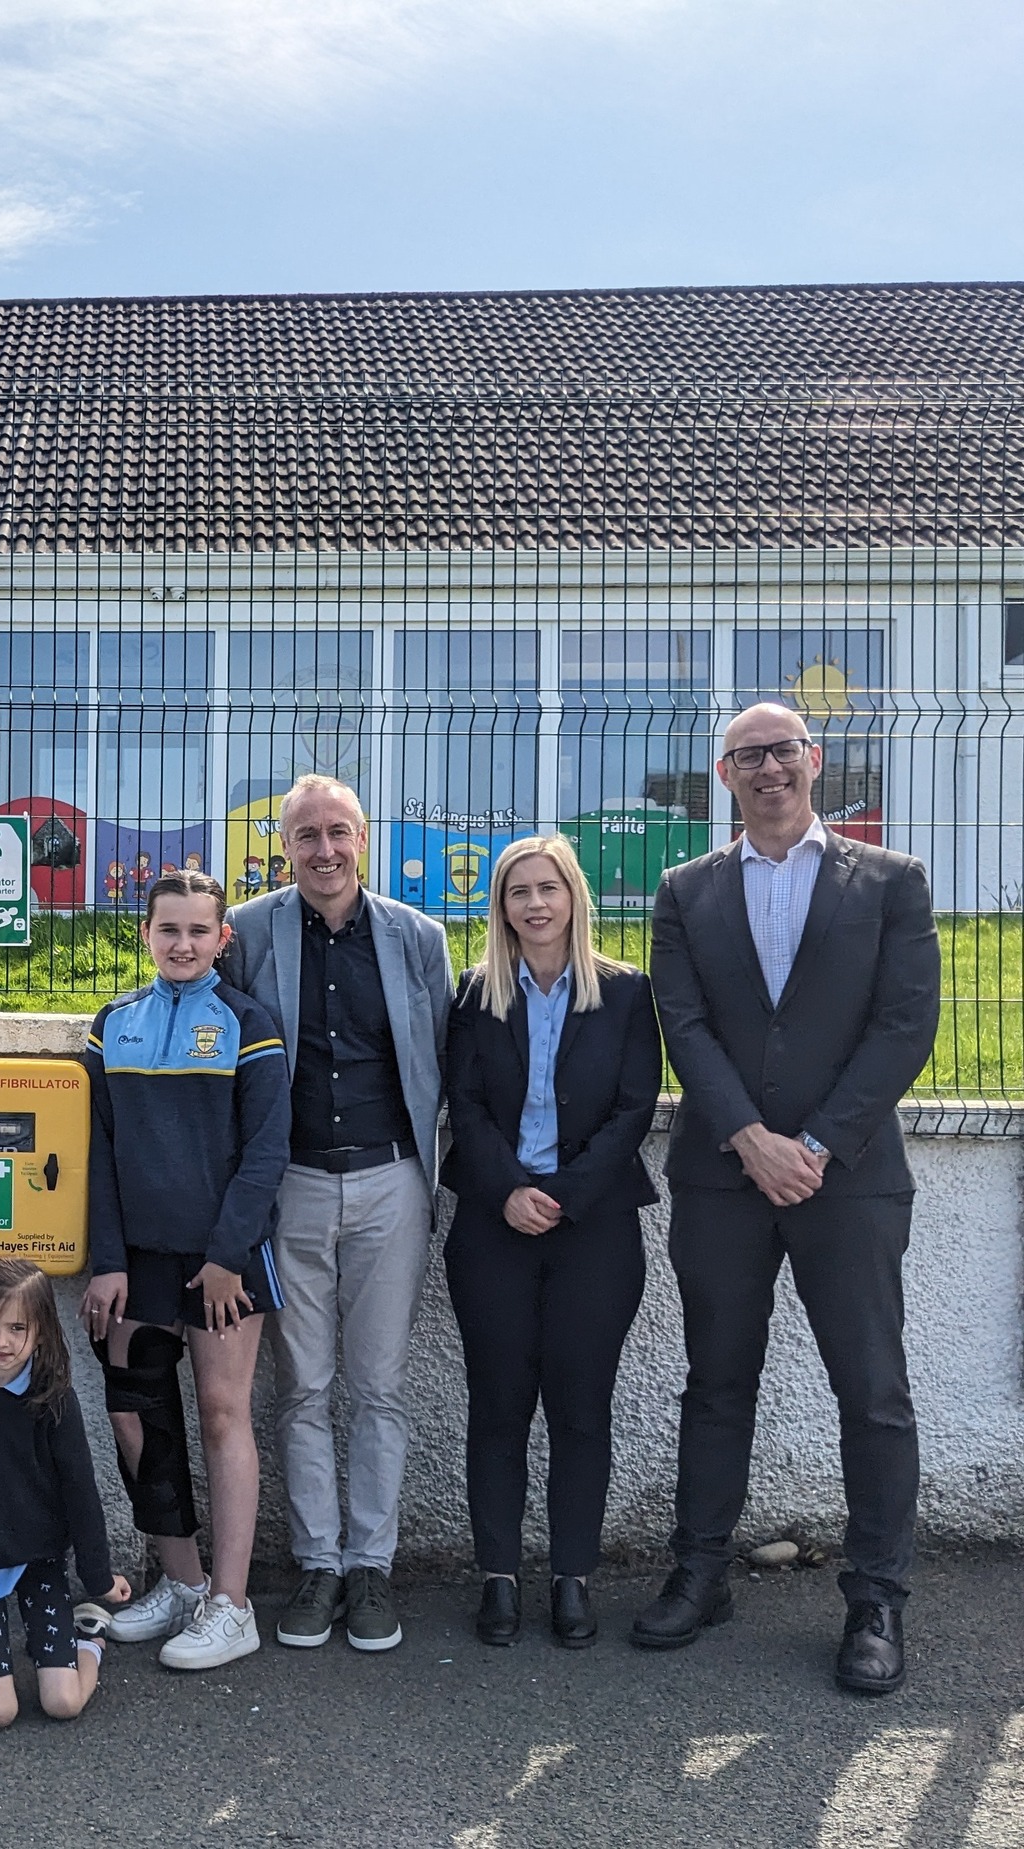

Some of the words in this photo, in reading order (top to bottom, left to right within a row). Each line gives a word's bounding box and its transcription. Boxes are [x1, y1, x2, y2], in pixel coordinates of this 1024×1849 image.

[601, 815, 645, 834] Fáilte
[17, 1232, 45, 1241] Supplied
[46, 1233, 55, 1241] by
[31, 1241, 56, 1252] First
[58, 1242, 76, 1252] Aid
